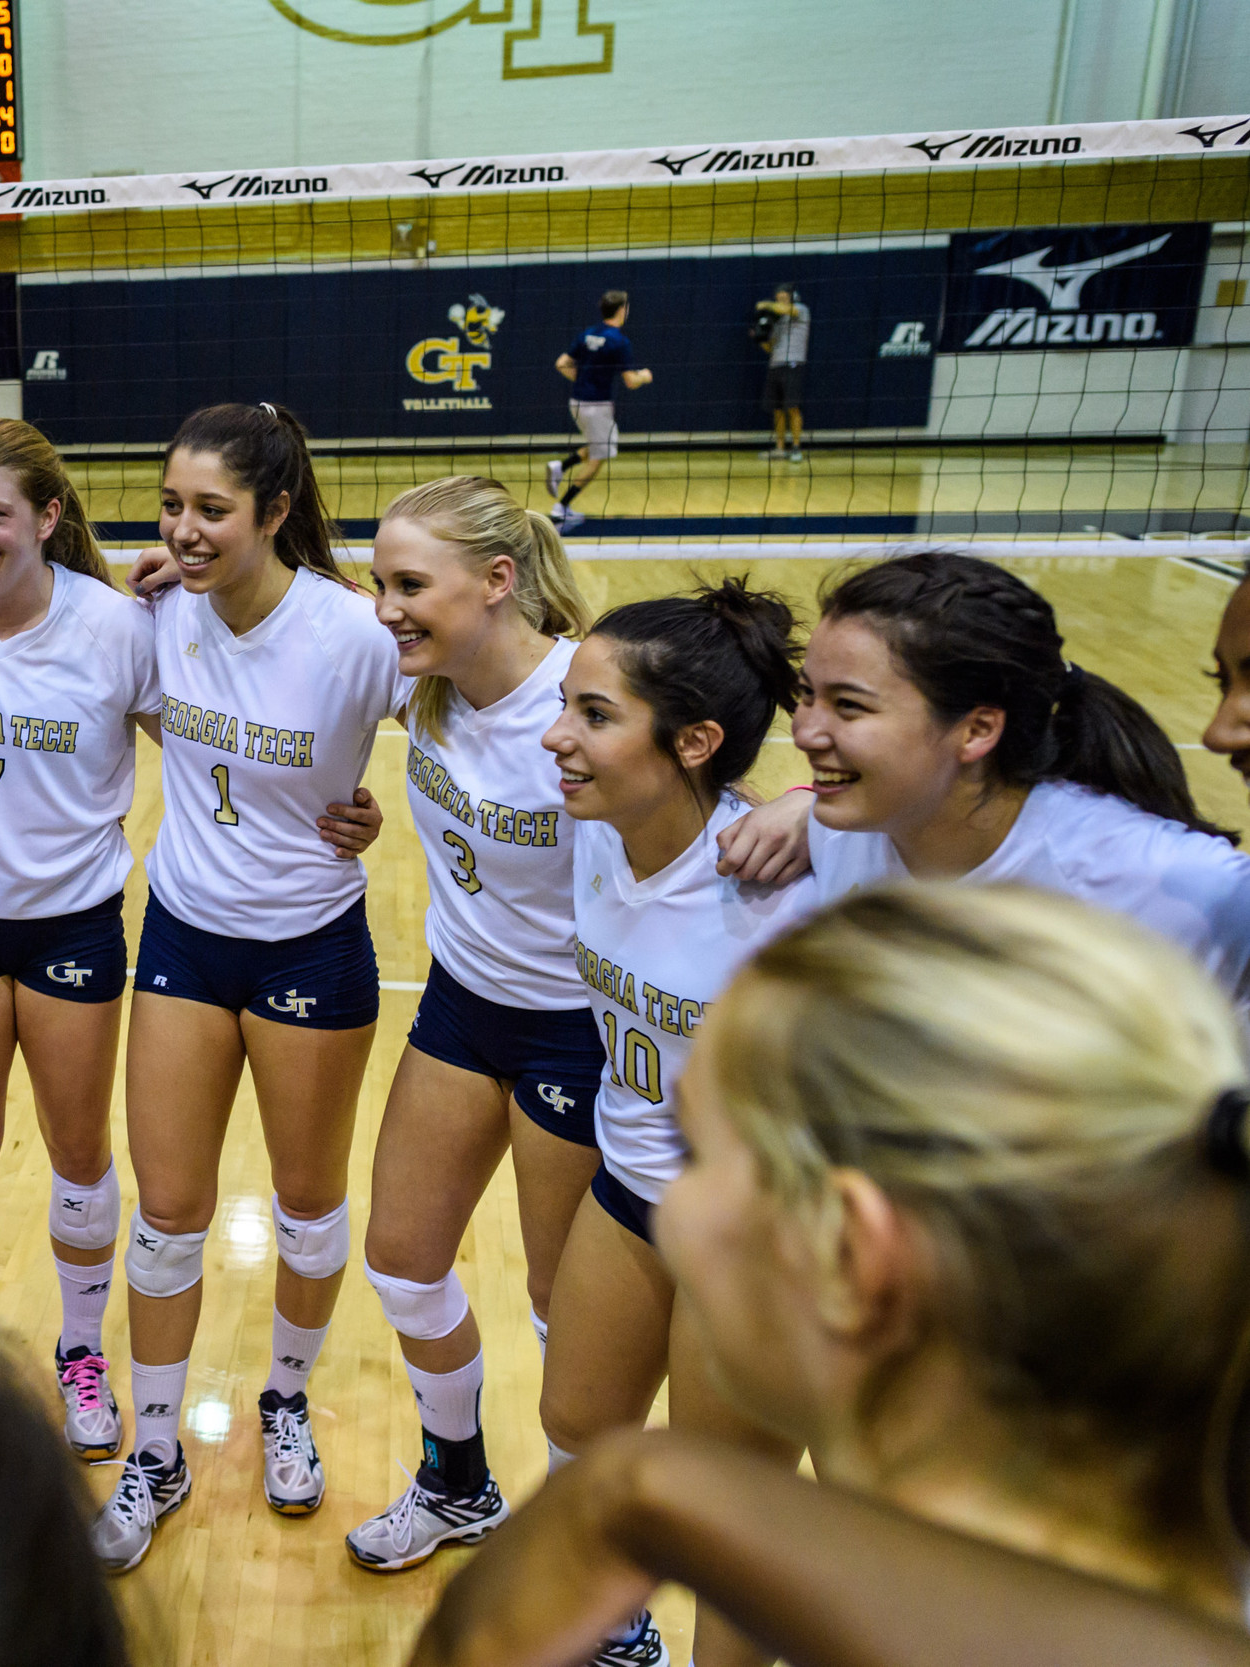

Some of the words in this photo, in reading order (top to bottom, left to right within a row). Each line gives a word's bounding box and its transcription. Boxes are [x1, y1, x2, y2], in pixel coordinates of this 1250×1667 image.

[0, 130, 15, 154] 0
[11, 186, 106, 208] MIZUNO
[227, 176, 328, 197] MIZUNO
[457, 164, 564, 186] MIZUNO
[701, 150, 815, 172] MIZUNO
[959, 135, 1082, 158] MIZUNO
[964, 307, 1158, 347] MIZUNO
[406, 337, 492, 391] GT
[11, 715, 79, 753] TECH
[161, 692, 238, 754] GEORGIA
[245, 721, 314, 767] TECH
[211, 764, 238, 826] 1
[478, 799, 558, 846] TECH
[443, 829, 482, 895] 3
[46, 961, 93, 987] GT
[267, 988, 317, 1018] GT
[603, 1010, 663, 1105] 10
[537, 1082, 576, 1114] GT
